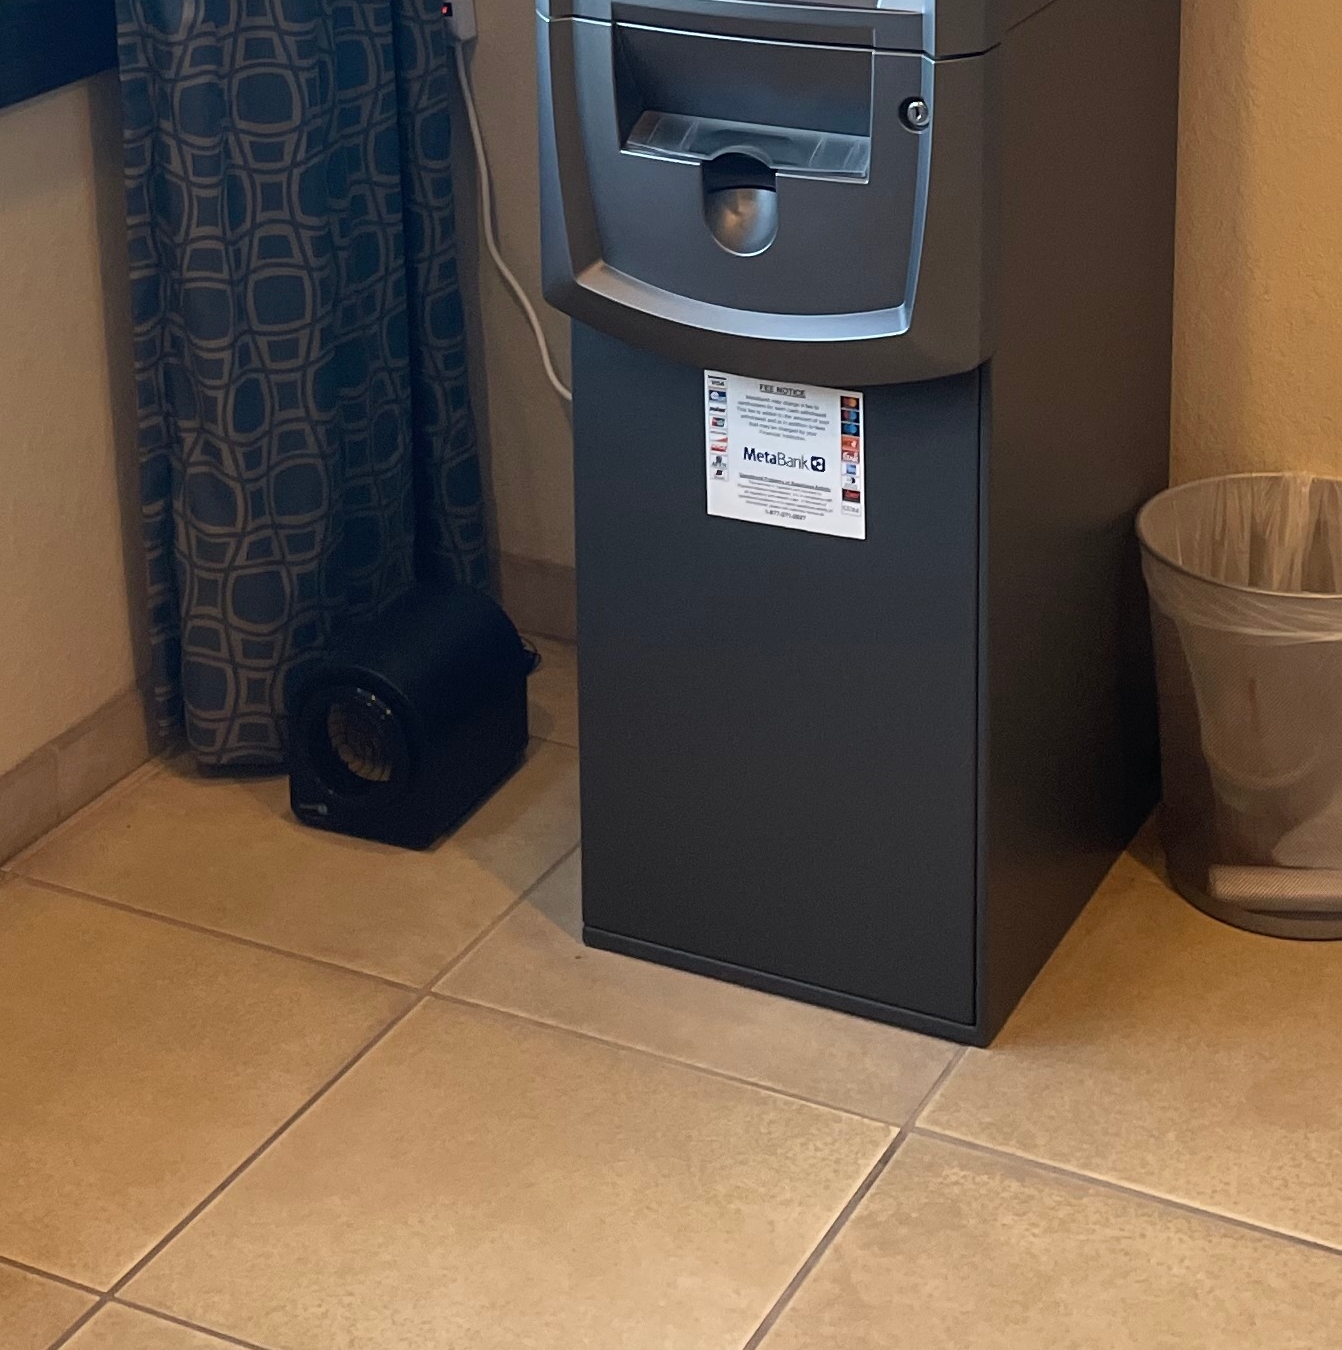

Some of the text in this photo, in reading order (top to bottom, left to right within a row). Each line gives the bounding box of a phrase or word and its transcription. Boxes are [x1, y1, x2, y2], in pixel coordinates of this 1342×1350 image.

[760, 383, 805, 397] FEE NOTICE
[743, 446, 809, 471] MetaBank
